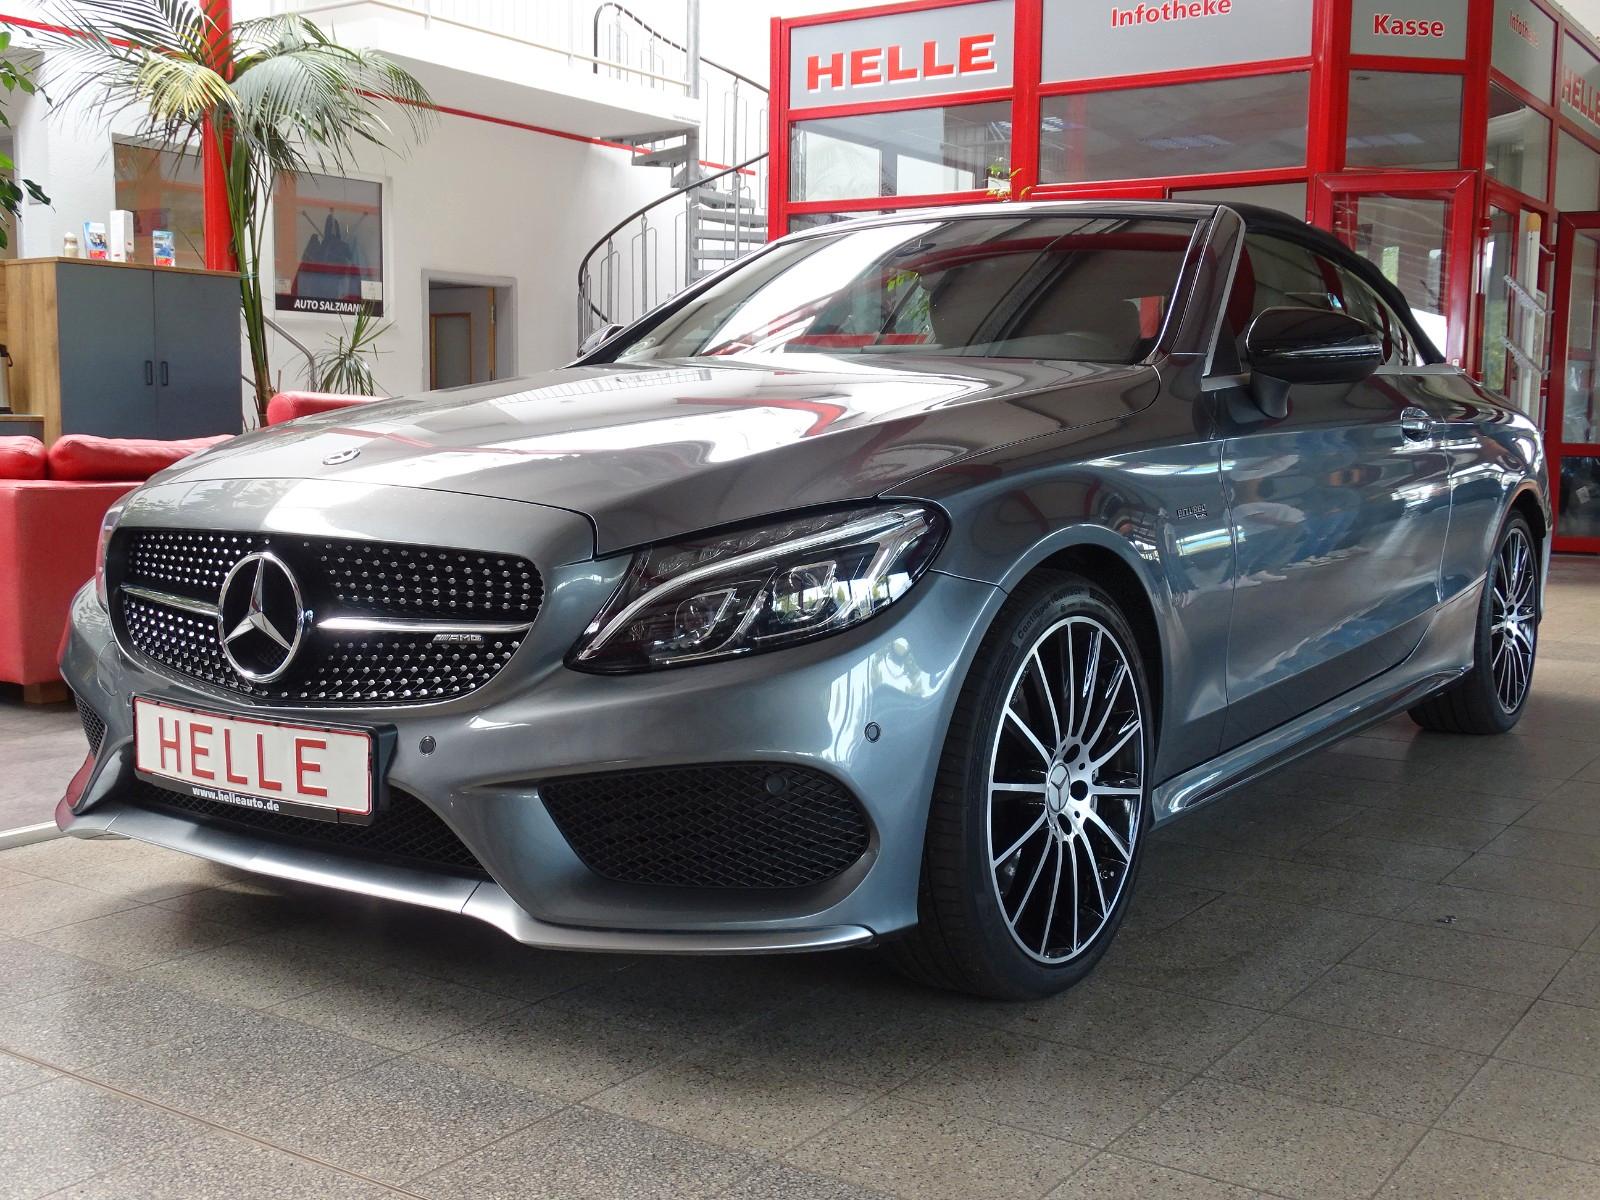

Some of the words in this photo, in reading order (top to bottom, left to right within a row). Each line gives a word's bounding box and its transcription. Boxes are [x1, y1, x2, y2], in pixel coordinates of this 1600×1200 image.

[1111, 0, 1232, 27] Infotheke
[1373, 14, 1445, 38] Kasse
[807, 33, 997, 94] HELLE
[294, 299, 319, 310] AUTO
[158, 716, 328, 798] HELLE
[192, 786, 280, 812] www.helleauto.de
